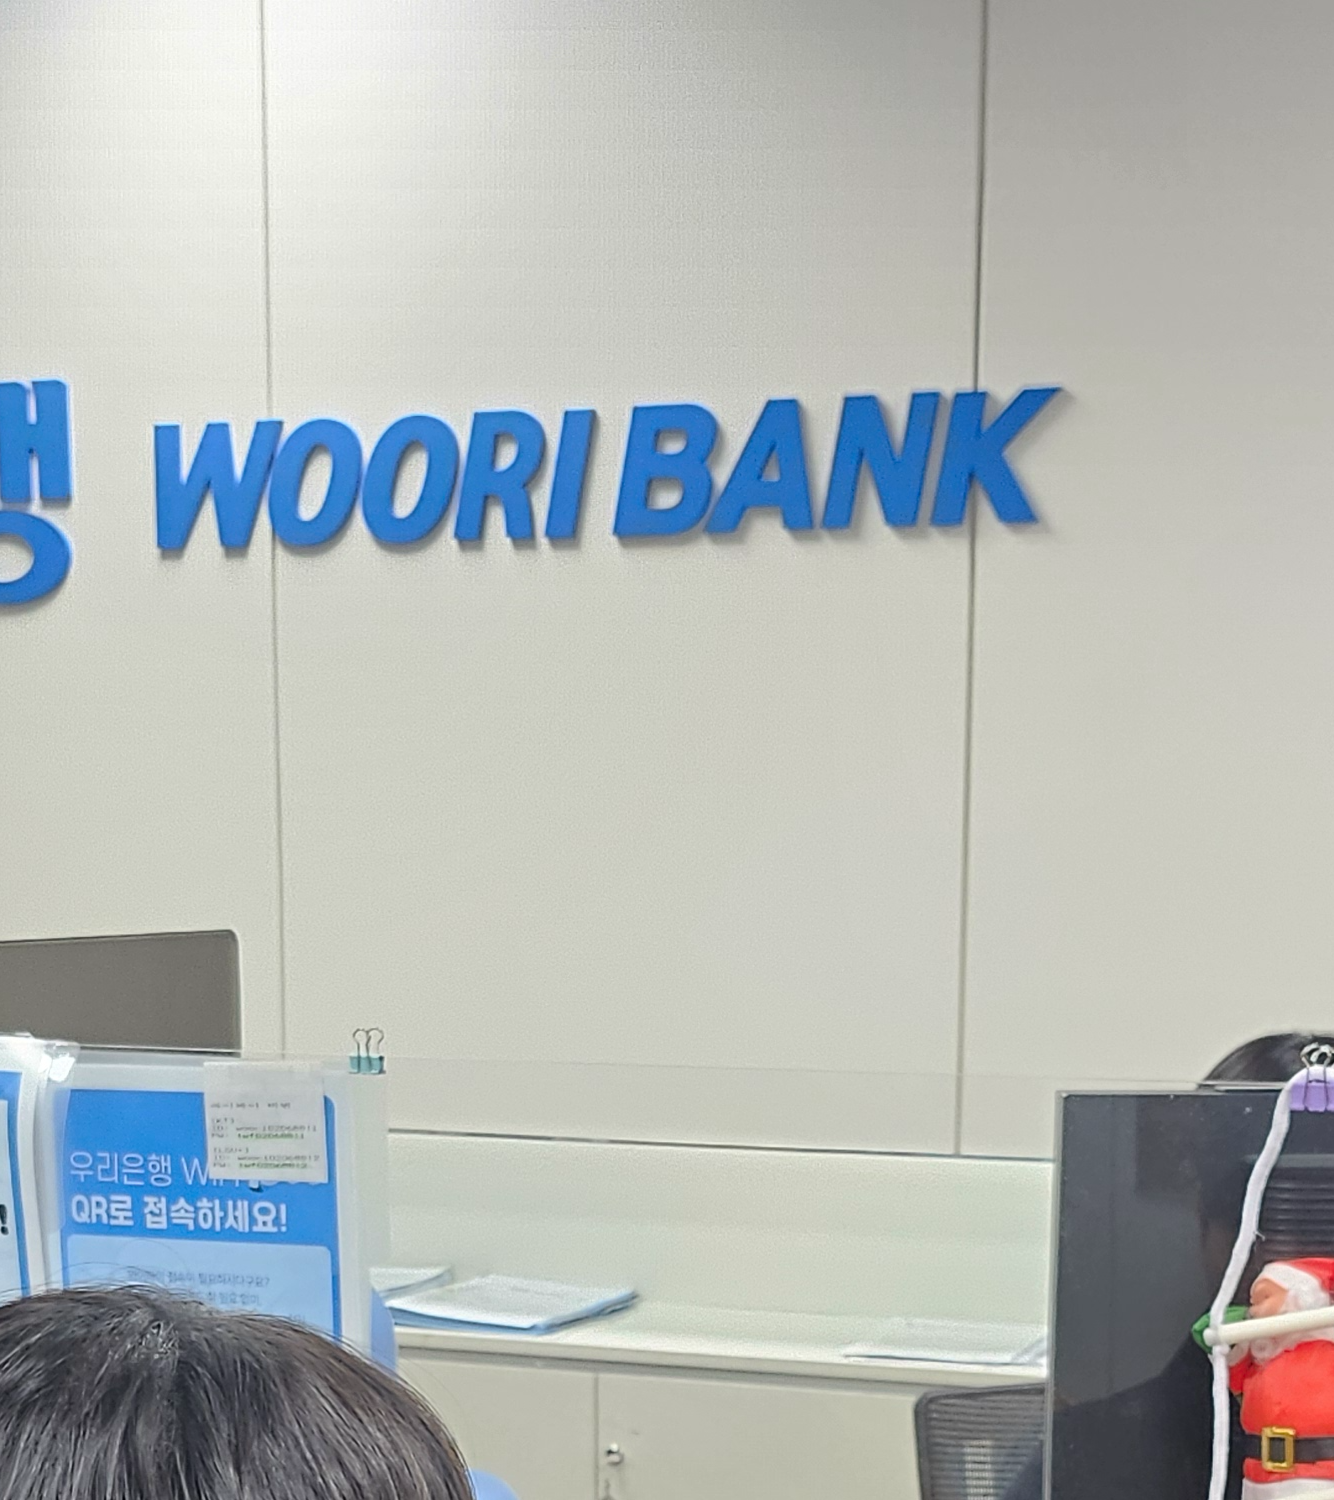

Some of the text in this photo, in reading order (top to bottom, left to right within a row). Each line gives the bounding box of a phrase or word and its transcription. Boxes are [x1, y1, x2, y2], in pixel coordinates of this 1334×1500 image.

[154, 387, 1064, 552] WOORI BANK
[70, 1151, 172, 1187] 우리은행
[71, 1194, 287, 1233] QR로 접속하세요!
